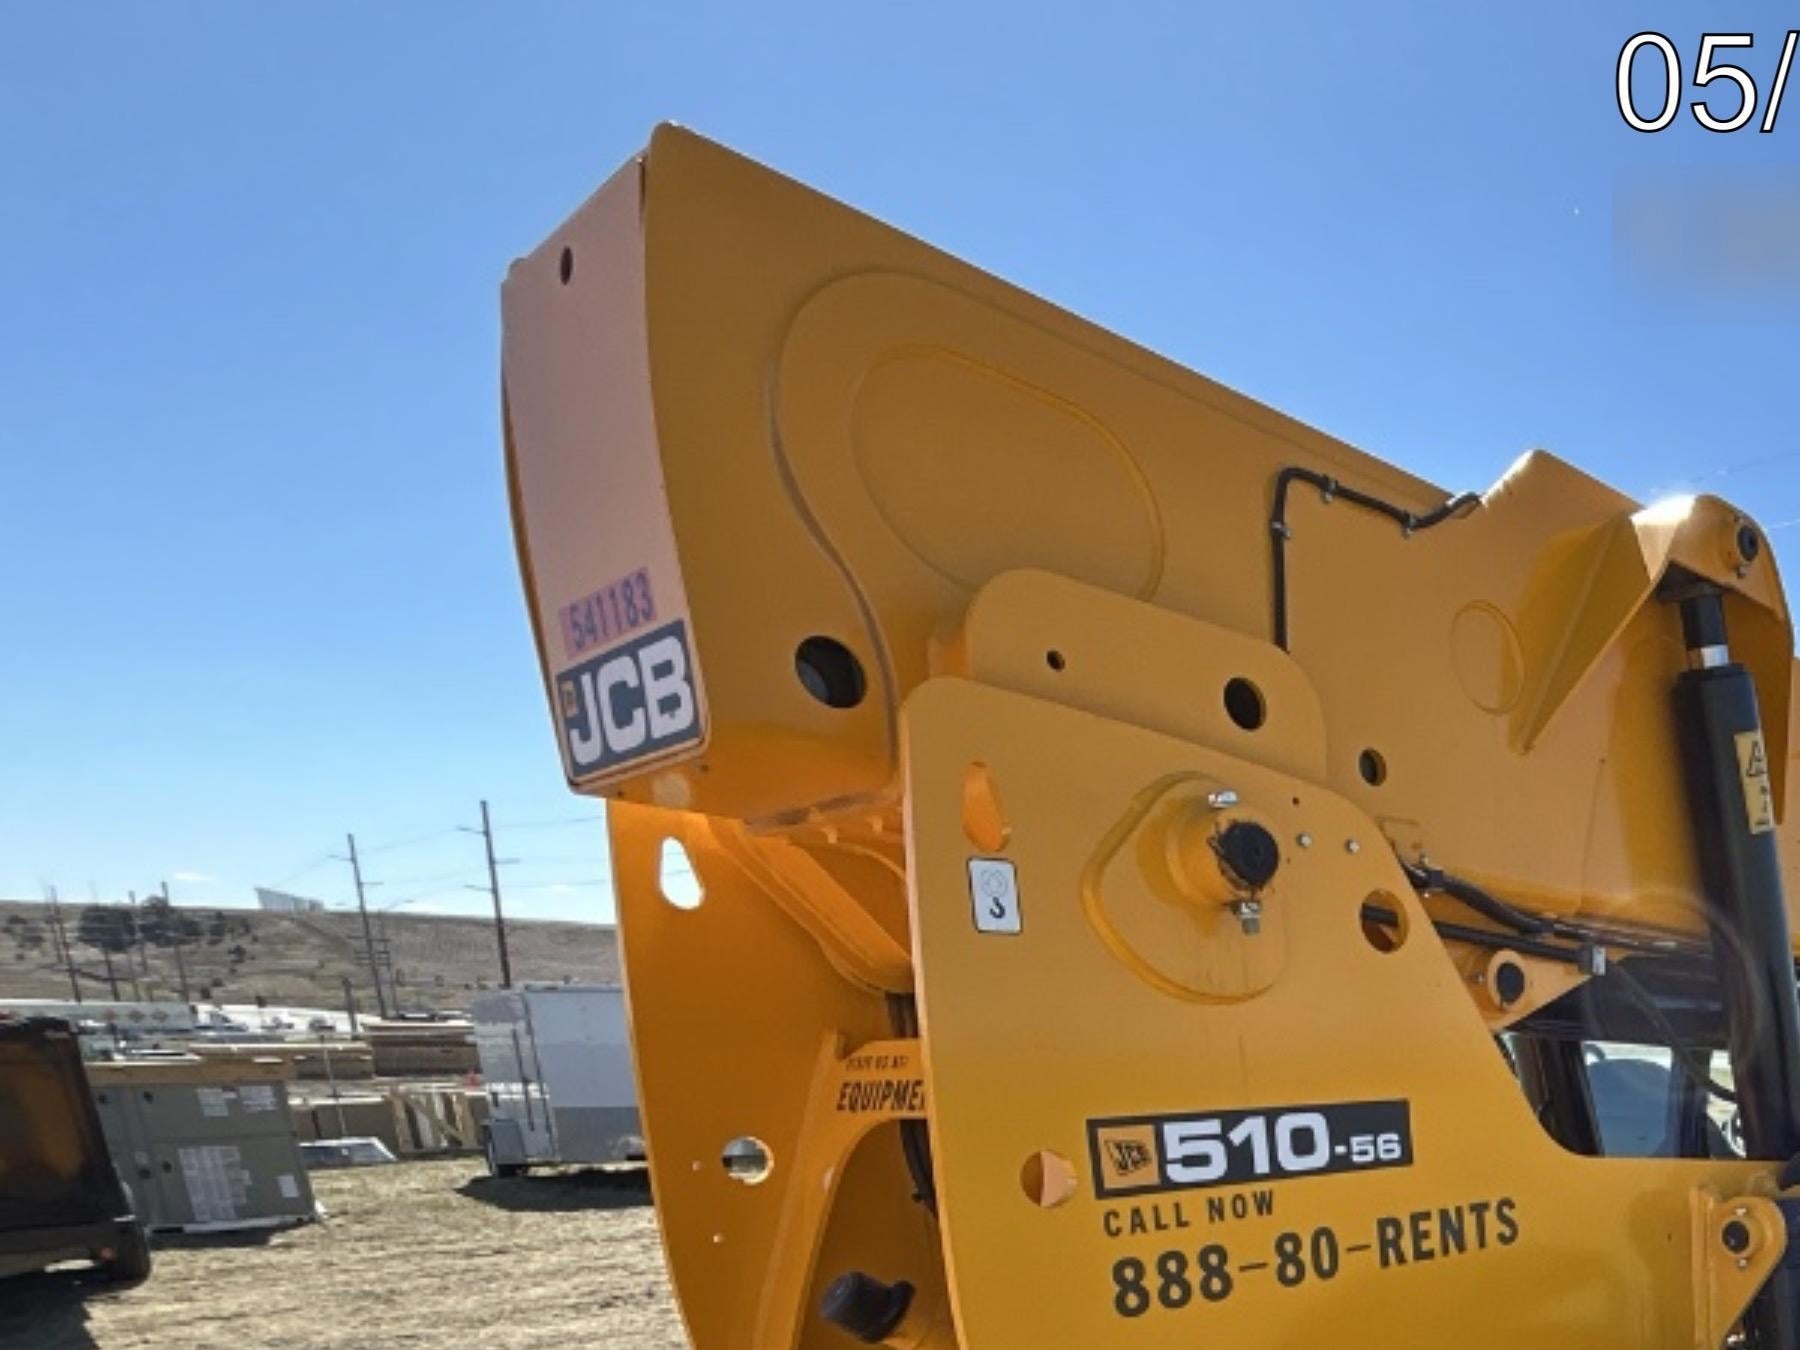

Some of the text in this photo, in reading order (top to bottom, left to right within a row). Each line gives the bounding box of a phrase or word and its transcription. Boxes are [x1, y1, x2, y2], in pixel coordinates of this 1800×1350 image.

[569, 571, 654, 650] 541183
[569, 635, 695, 766] JCB
[1162, 1111, 1401, 1185] 510-56
[1103, 1189, 1274, 1238] CALL NOW
[1111, 1197, 1520, 1319] 888-80-RENTS
